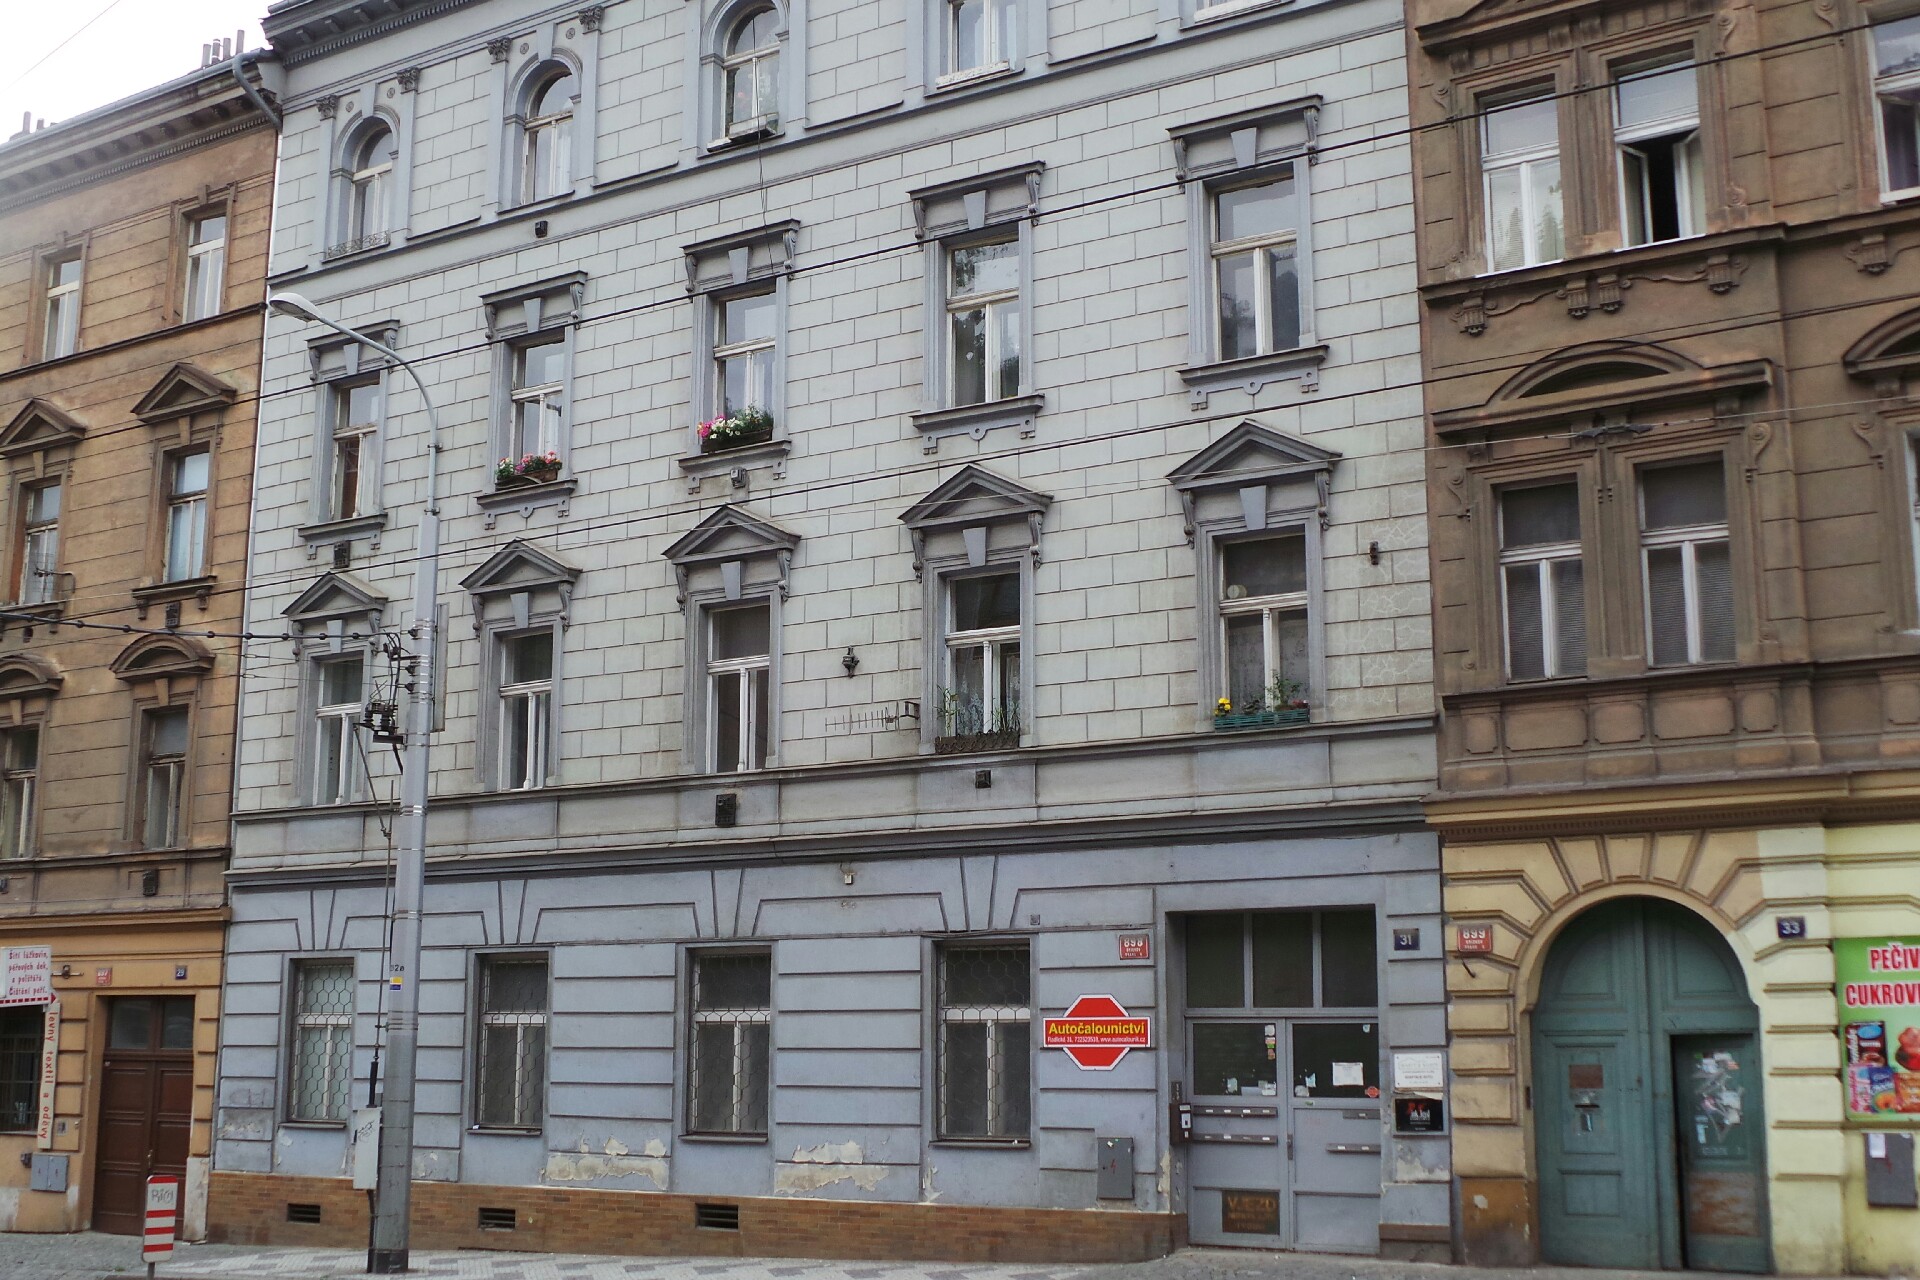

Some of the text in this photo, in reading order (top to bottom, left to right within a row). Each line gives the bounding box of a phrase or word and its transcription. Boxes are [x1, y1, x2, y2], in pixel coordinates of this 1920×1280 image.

[1462, 927, 1486, 939] 899
[1781, 921, 1800, 934] 33
[1123, 937, 1143, 947] 898
[1399, 934, 1412, 946] 31
[176, 968, 185, 977] 29
[1048, 1022, 1145, 1034] Autočalounictví
[45, 1051, 54, 1084] textil
